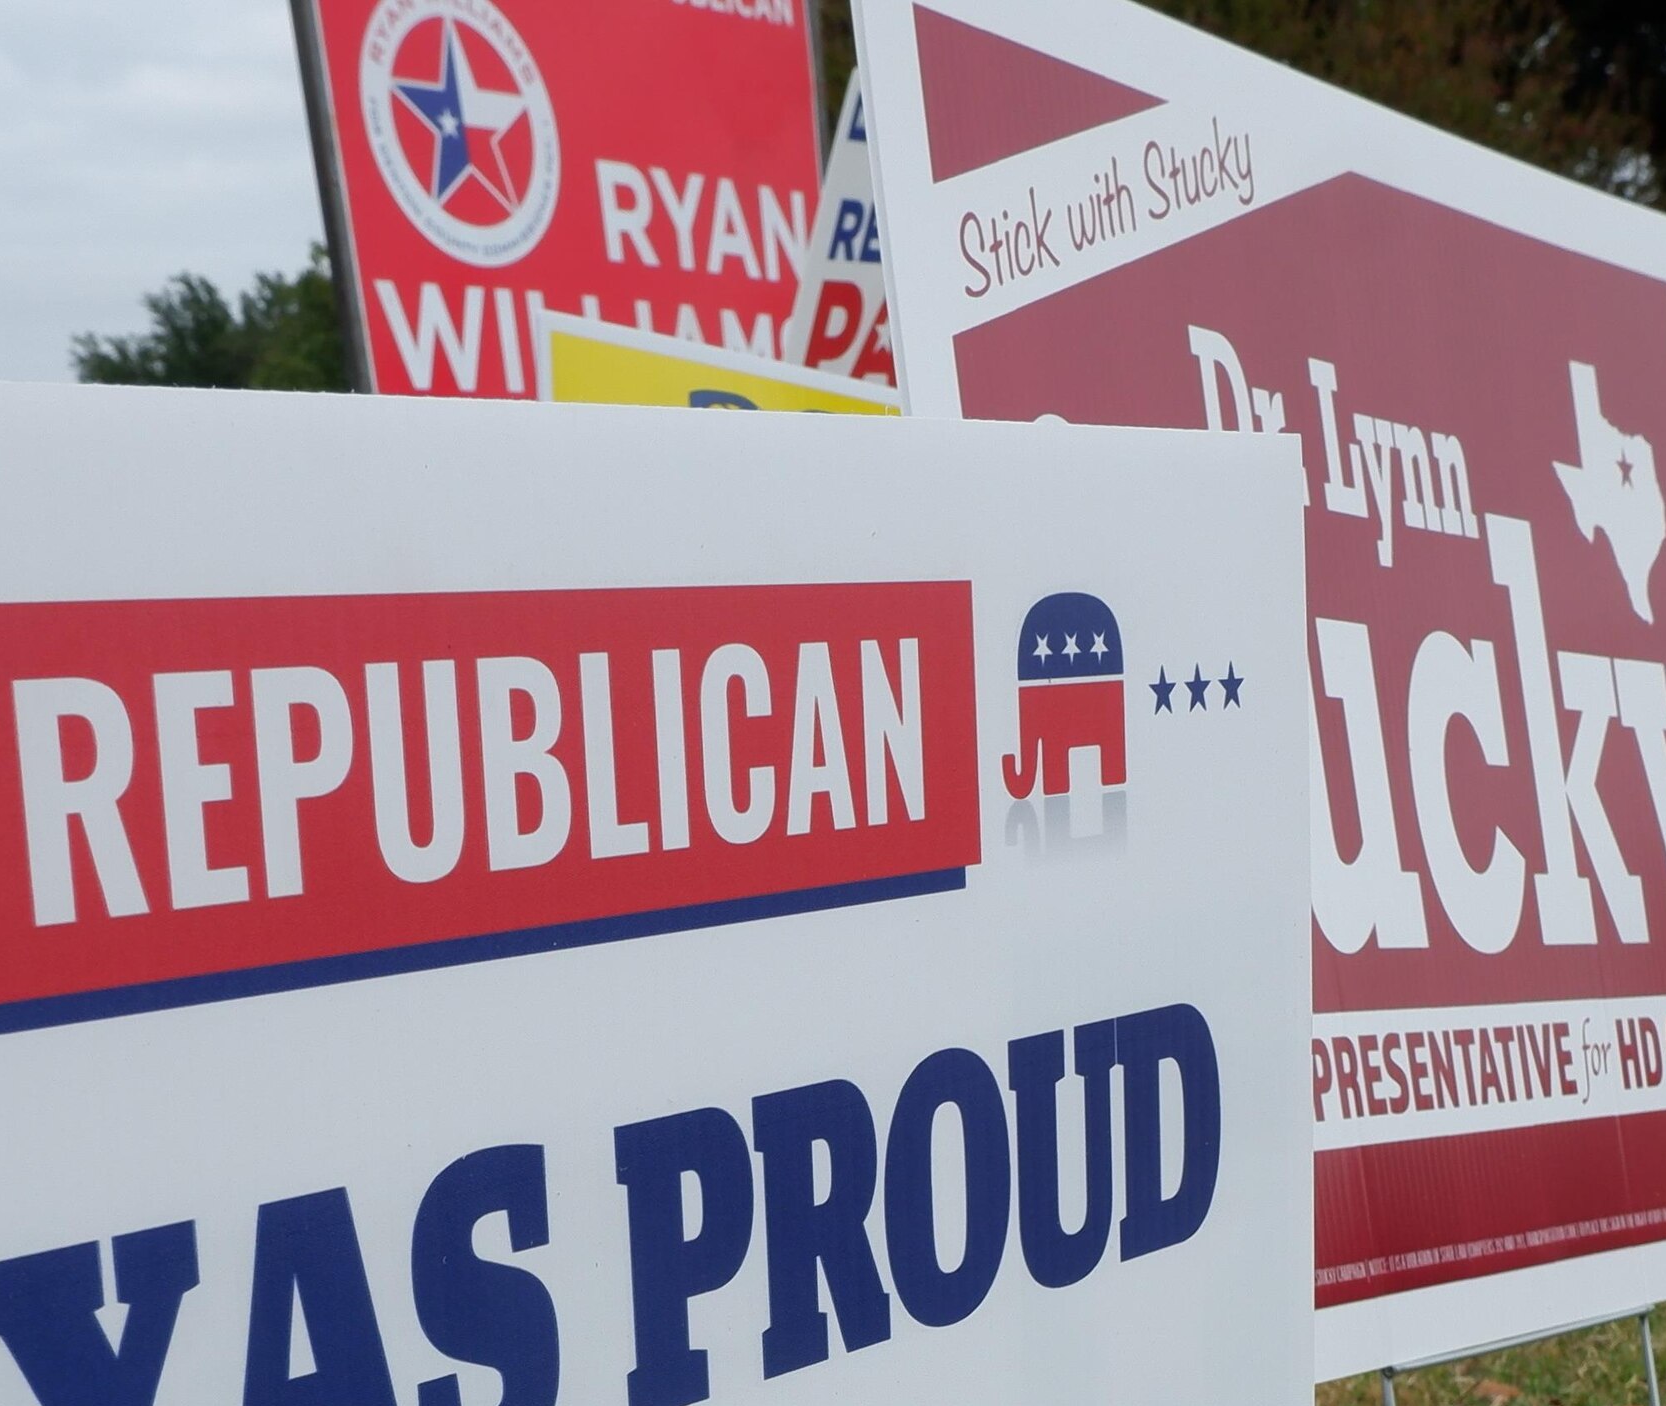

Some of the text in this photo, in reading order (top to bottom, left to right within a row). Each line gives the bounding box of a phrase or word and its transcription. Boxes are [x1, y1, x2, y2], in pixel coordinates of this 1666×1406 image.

[594, 158, 810, 282] RYAN
[960, 116, 1254, 298] Stick with Stucky
[1308, 358, 1480, 567] Lynn
[12, 640, 925, 926] REPUBLICAN
[1581, 1017, 1612, 1104] for
[1615, 1016, 1664, 1090] HD
